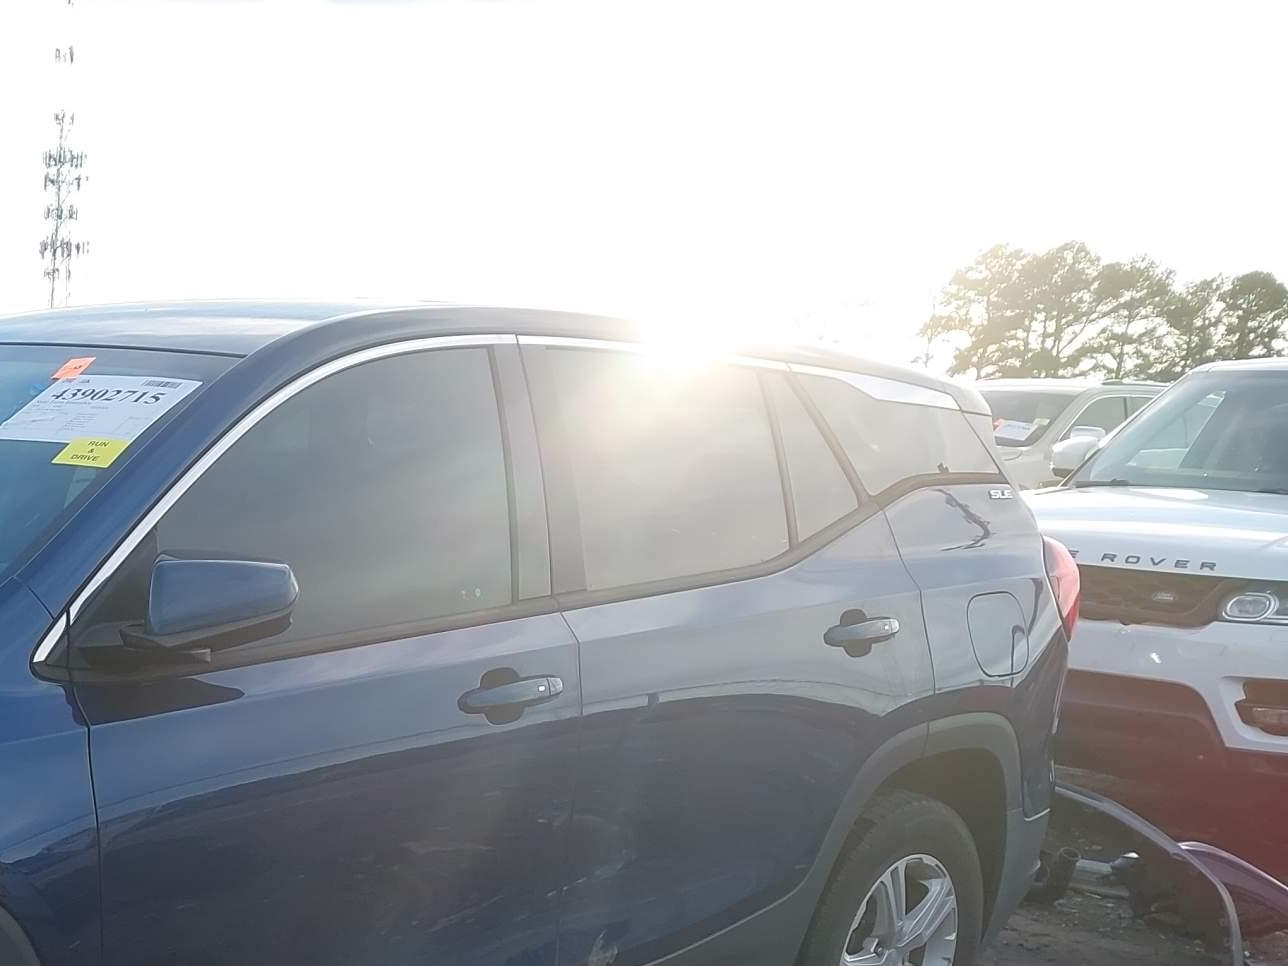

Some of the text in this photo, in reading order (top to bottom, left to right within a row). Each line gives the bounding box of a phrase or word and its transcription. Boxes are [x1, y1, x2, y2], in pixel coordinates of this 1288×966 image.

[51, 387, 166, 405] 43902715
[87, 440, 111, 448] RUN
[70, 454, 101, 462] DRIVE
[1100, 552, 1218, 572] ROVER
